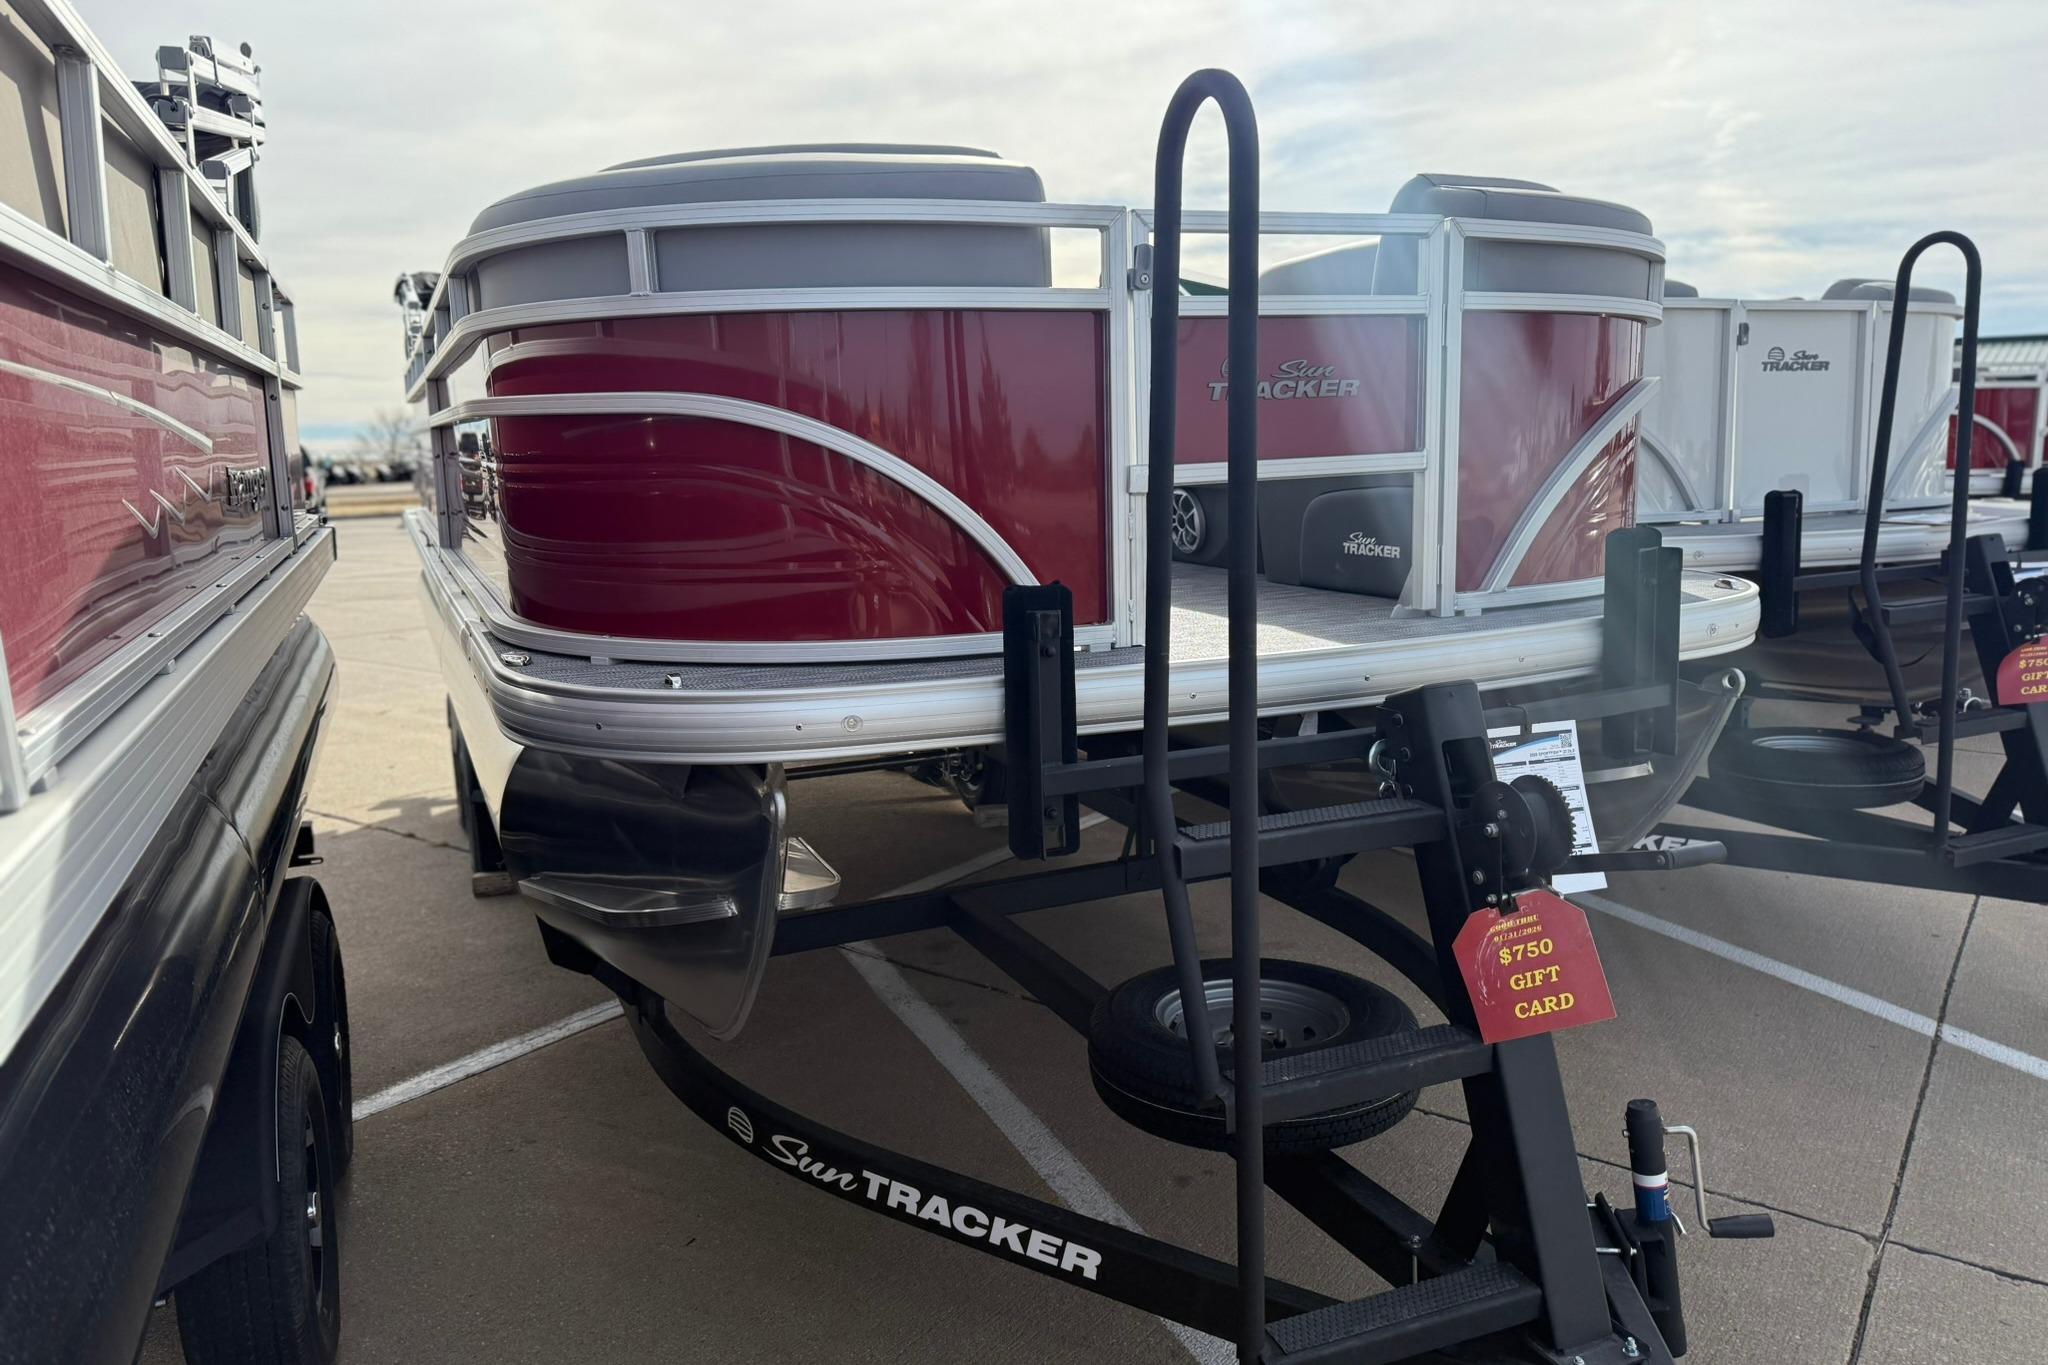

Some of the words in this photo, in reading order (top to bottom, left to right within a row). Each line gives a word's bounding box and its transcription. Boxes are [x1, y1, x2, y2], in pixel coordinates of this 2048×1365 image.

[1272, 359, 1335, 379] Sun
[1761, 361, 1830, 372] TRACKER
[1208, 379, 1360, 401] TACKER
[1344, 532, 1377, 545] Sun
[1343, 542, 1401, 559] TRACKER
[2021, 684, 2048, 695] CAR
[1516, 914, 1540, 925] THRU
[1499, 938, 1553, 966] $750
[1510, 965, 1560, 990] GIFT
[1514, 992, 1575, 1019] CARD
[762, 1134, 859, 1191] Sun
[861, 1170, 1103, 1281] TRACKER
